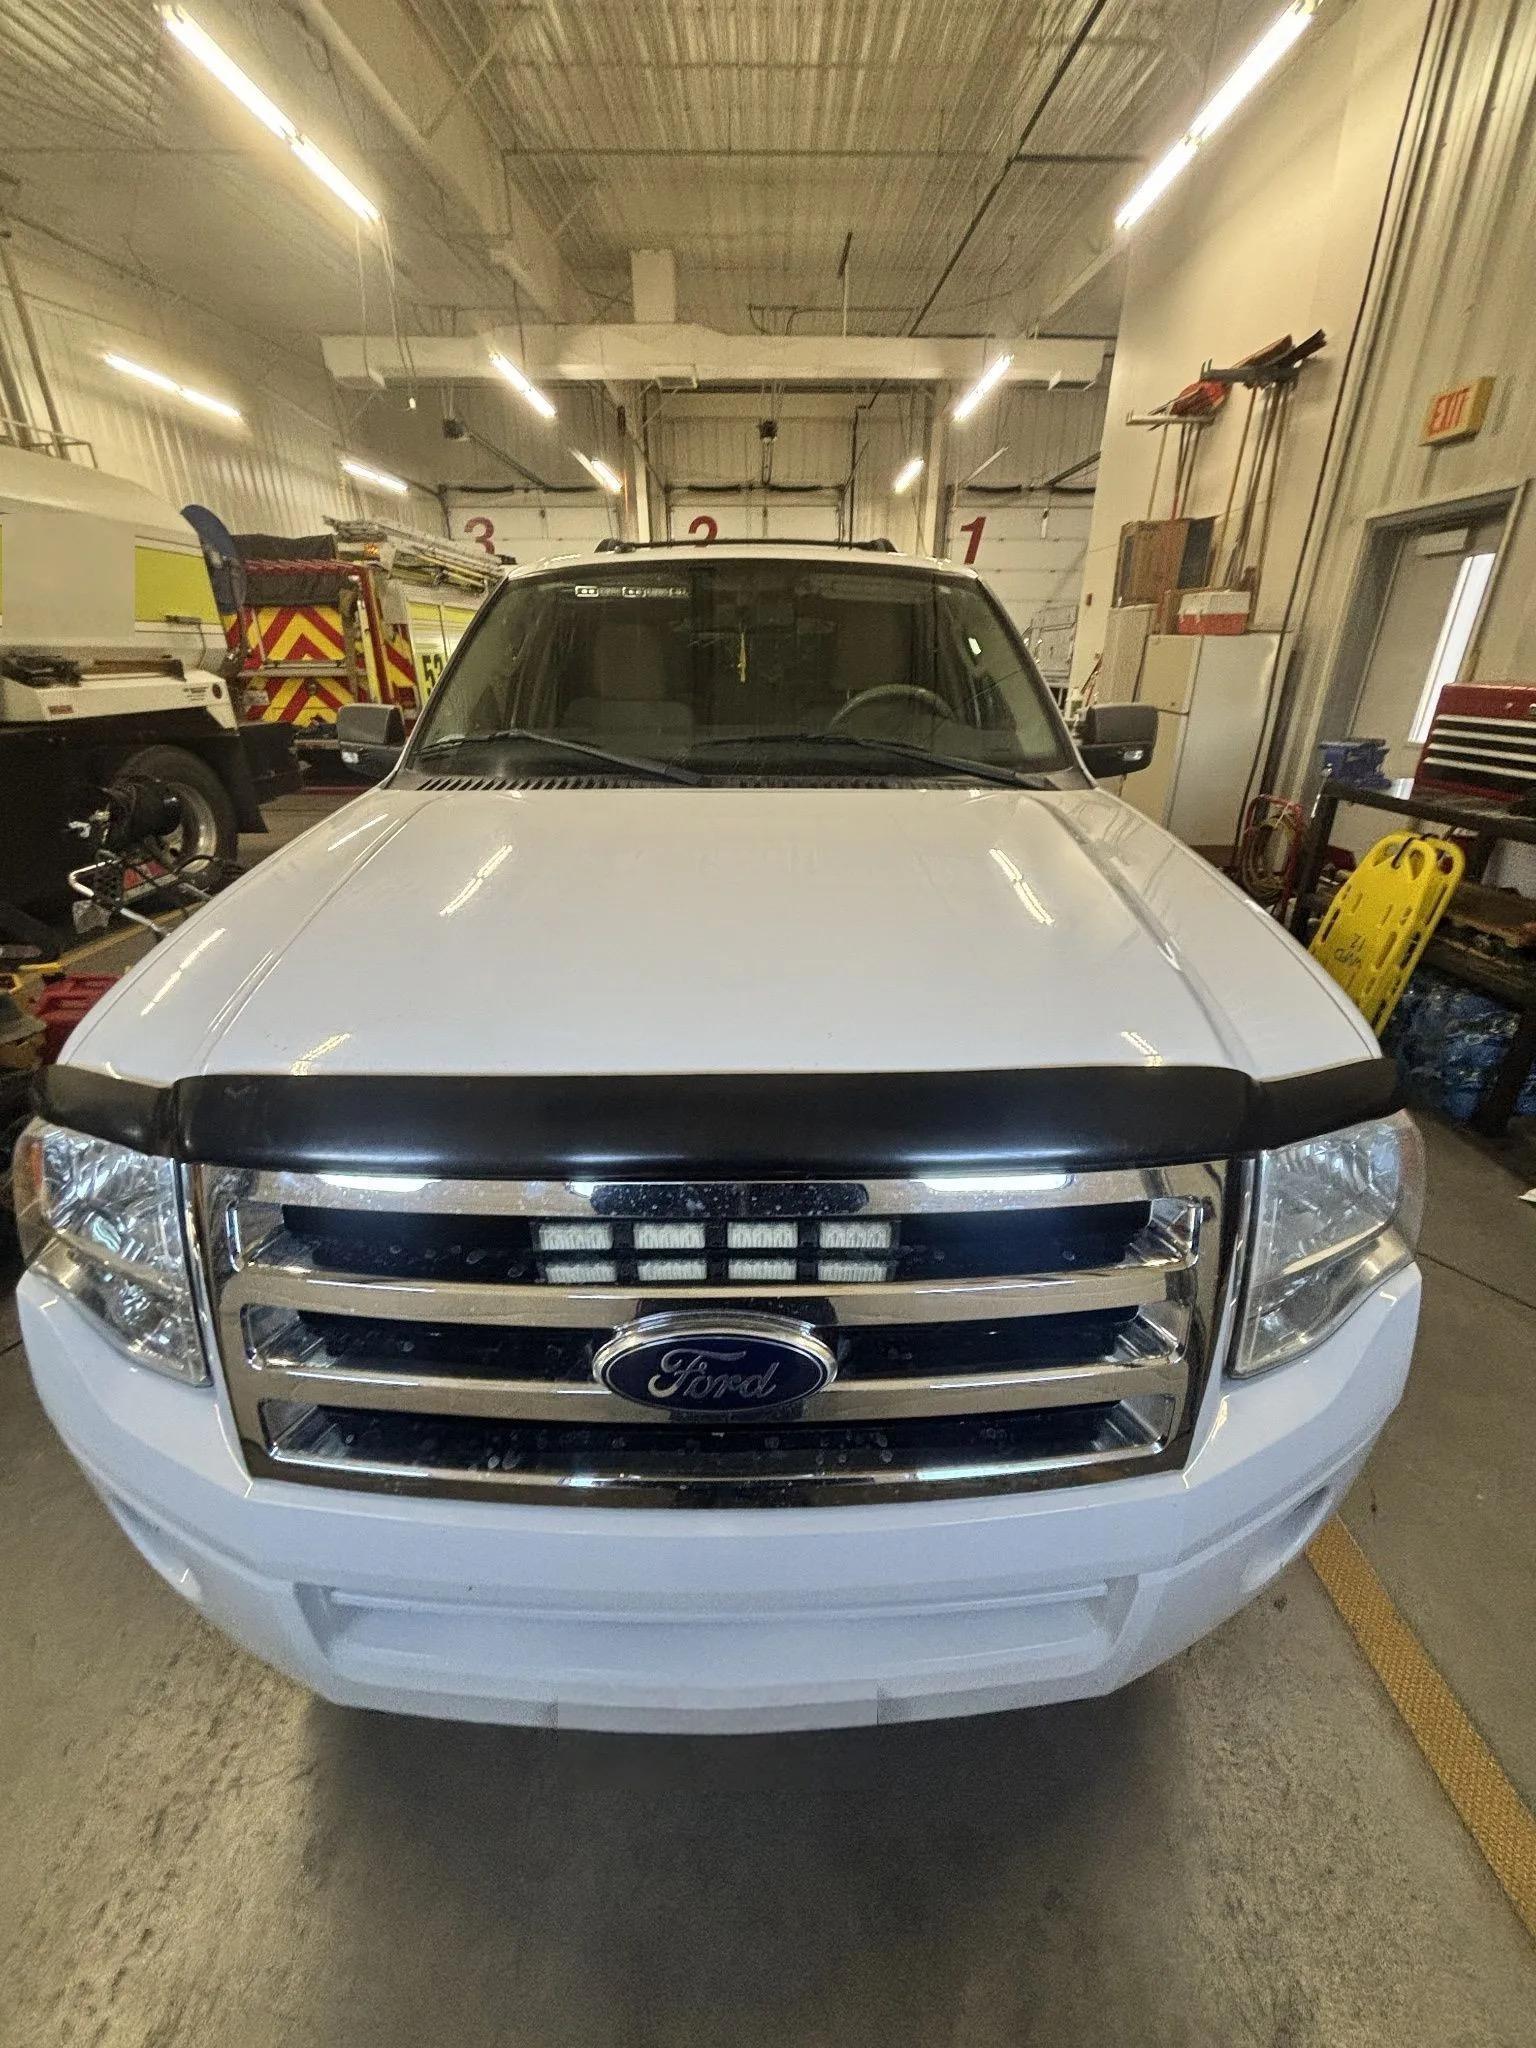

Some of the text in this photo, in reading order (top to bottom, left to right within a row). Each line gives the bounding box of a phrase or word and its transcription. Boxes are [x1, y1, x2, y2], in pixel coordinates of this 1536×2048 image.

[464, 517, 495, 555] 3
[961, 516, 987, 565] 1
[648, 1348, 781, 1398] Ford
